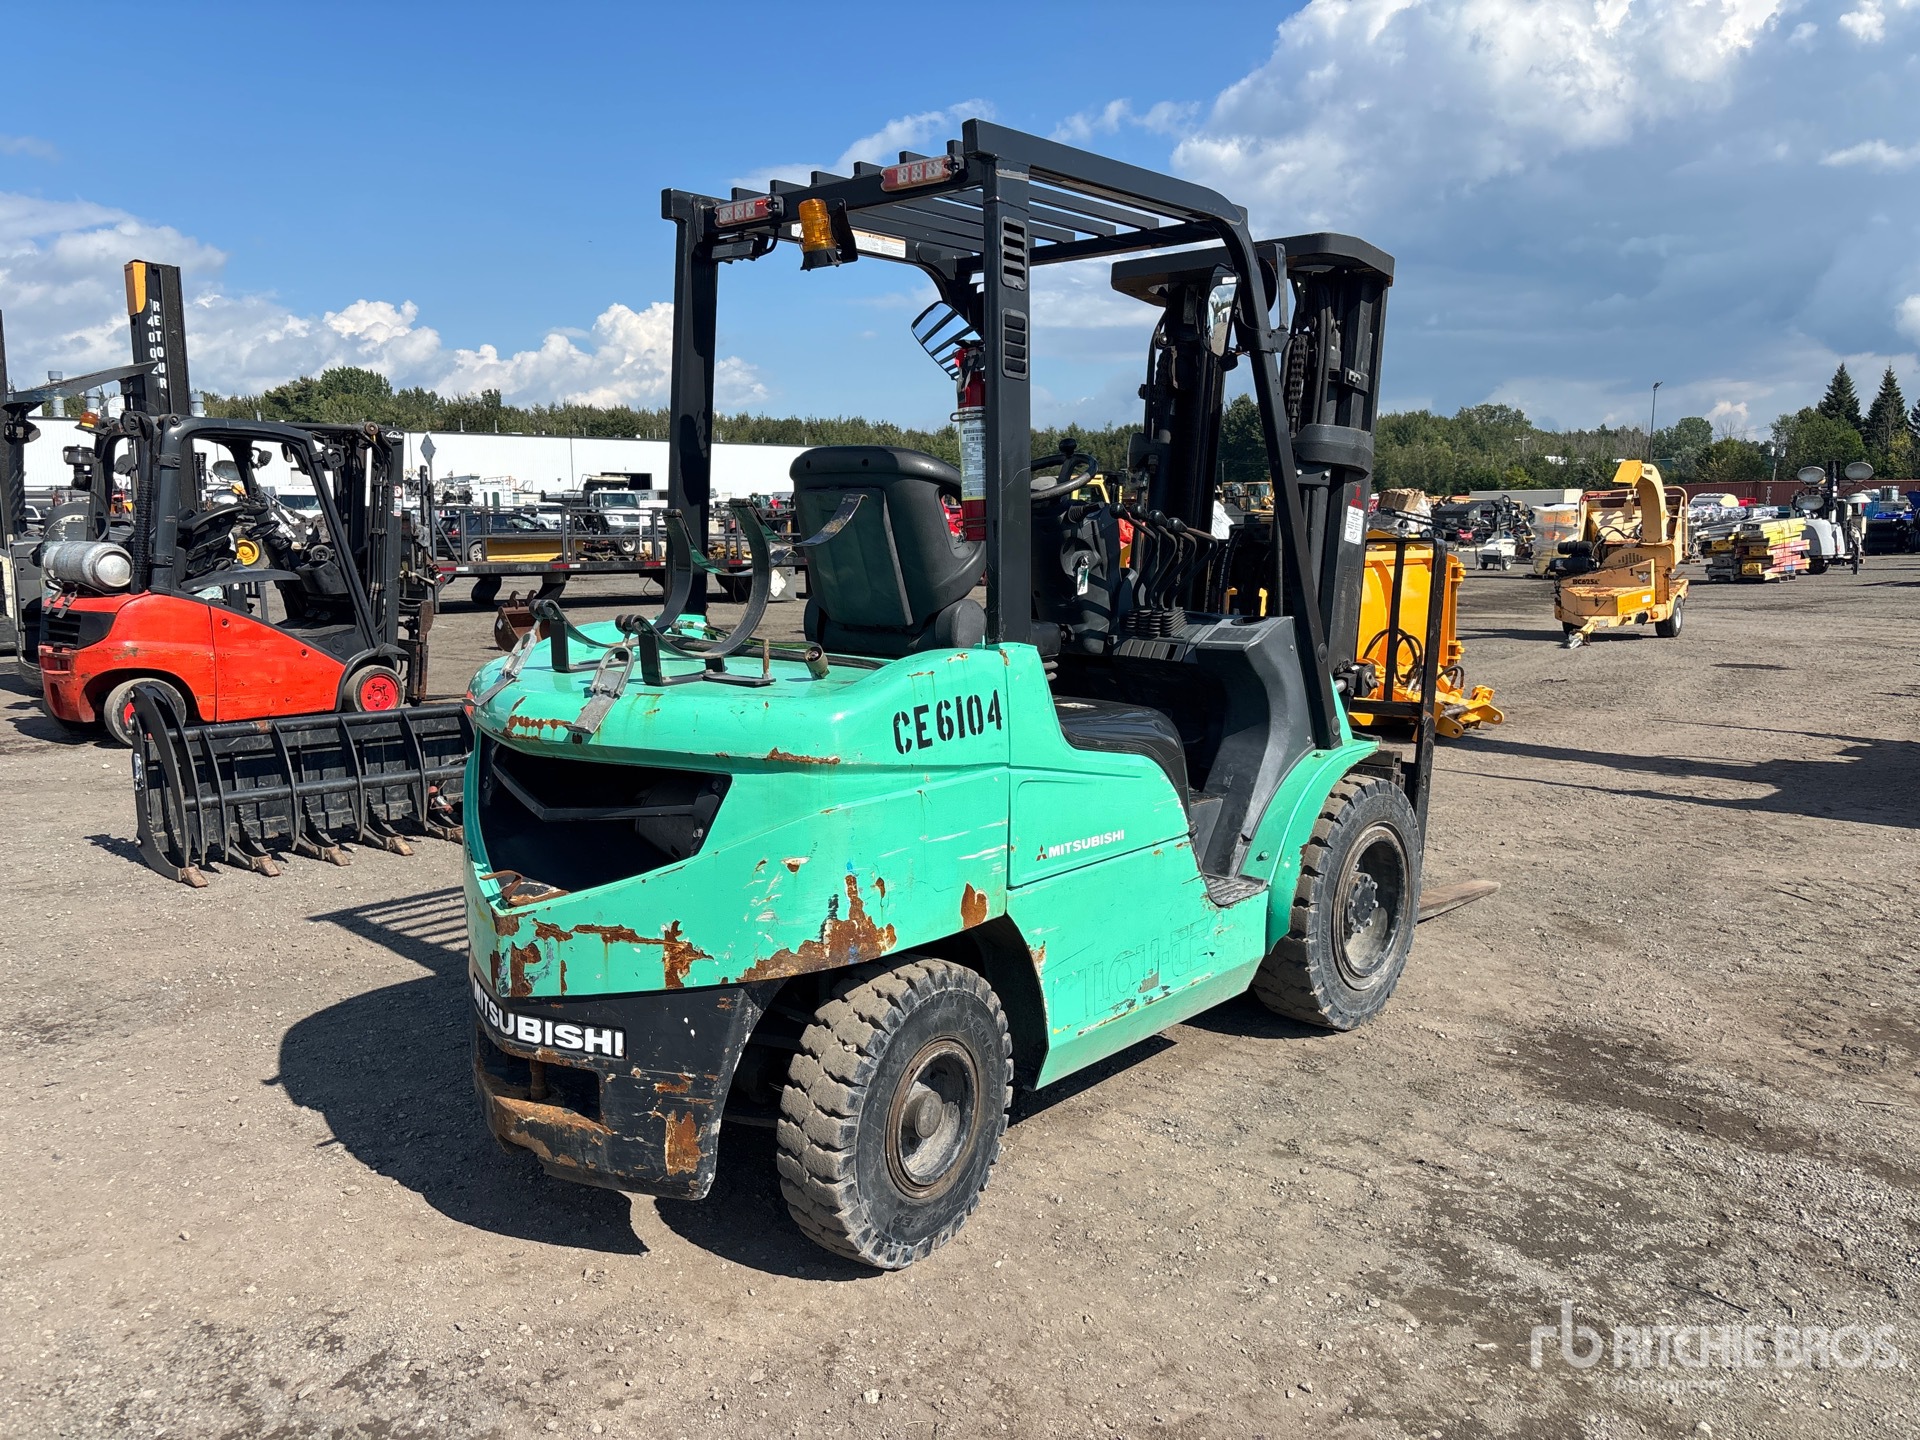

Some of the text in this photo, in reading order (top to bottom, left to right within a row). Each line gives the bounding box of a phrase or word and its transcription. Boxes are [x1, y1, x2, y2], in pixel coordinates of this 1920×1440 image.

[152, 300, 168, 389] RETOUR
[892, 689, 1003, 755] CE6104
[1048, 829, 1125, 859] MITSUBISHI
[474, 975, 625, 1058] MITSUBISHI
